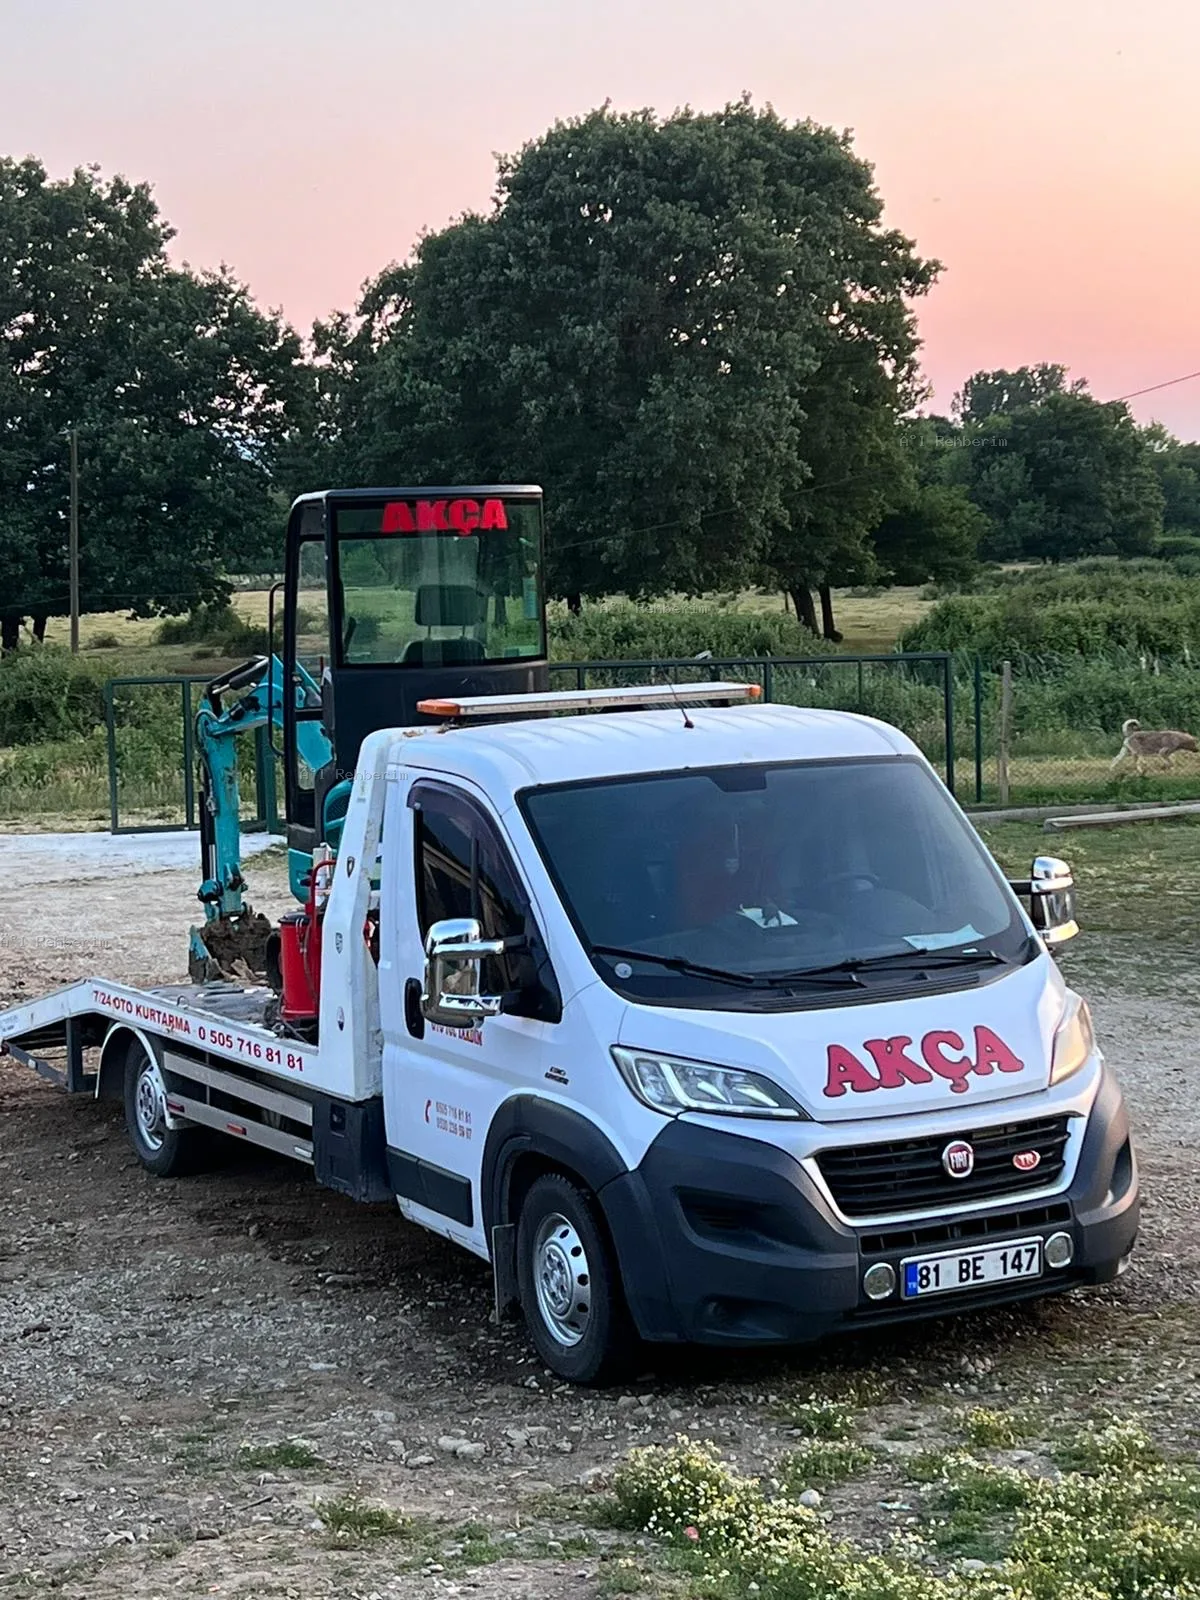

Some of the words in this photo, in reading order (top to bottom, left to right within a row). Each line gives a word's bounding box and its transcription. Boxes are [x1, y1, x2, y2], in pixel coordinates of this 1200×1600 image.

[382, 498, 508, 535] AKÇA
[112, 996, 133, 1014] OTO
[135, 1003, 191, 1035] KURTARMA
[198, 1026, 206, 1040] 0
[210, 1030, 233, 1049] 505
[237, 1037, 262, 1058] 716
[265, 1047, 281, 1065] 81
[287, 1053, 304, 1072] 81
[823, 1025, 1025, 1098] AKÇA
[949, 1150, 969, 1169] FIAT
[918, 1263, 940, 1289] 81
[958, 1255, 985, 1283] BE
[1000, 1247, 1037, 1275] 147
